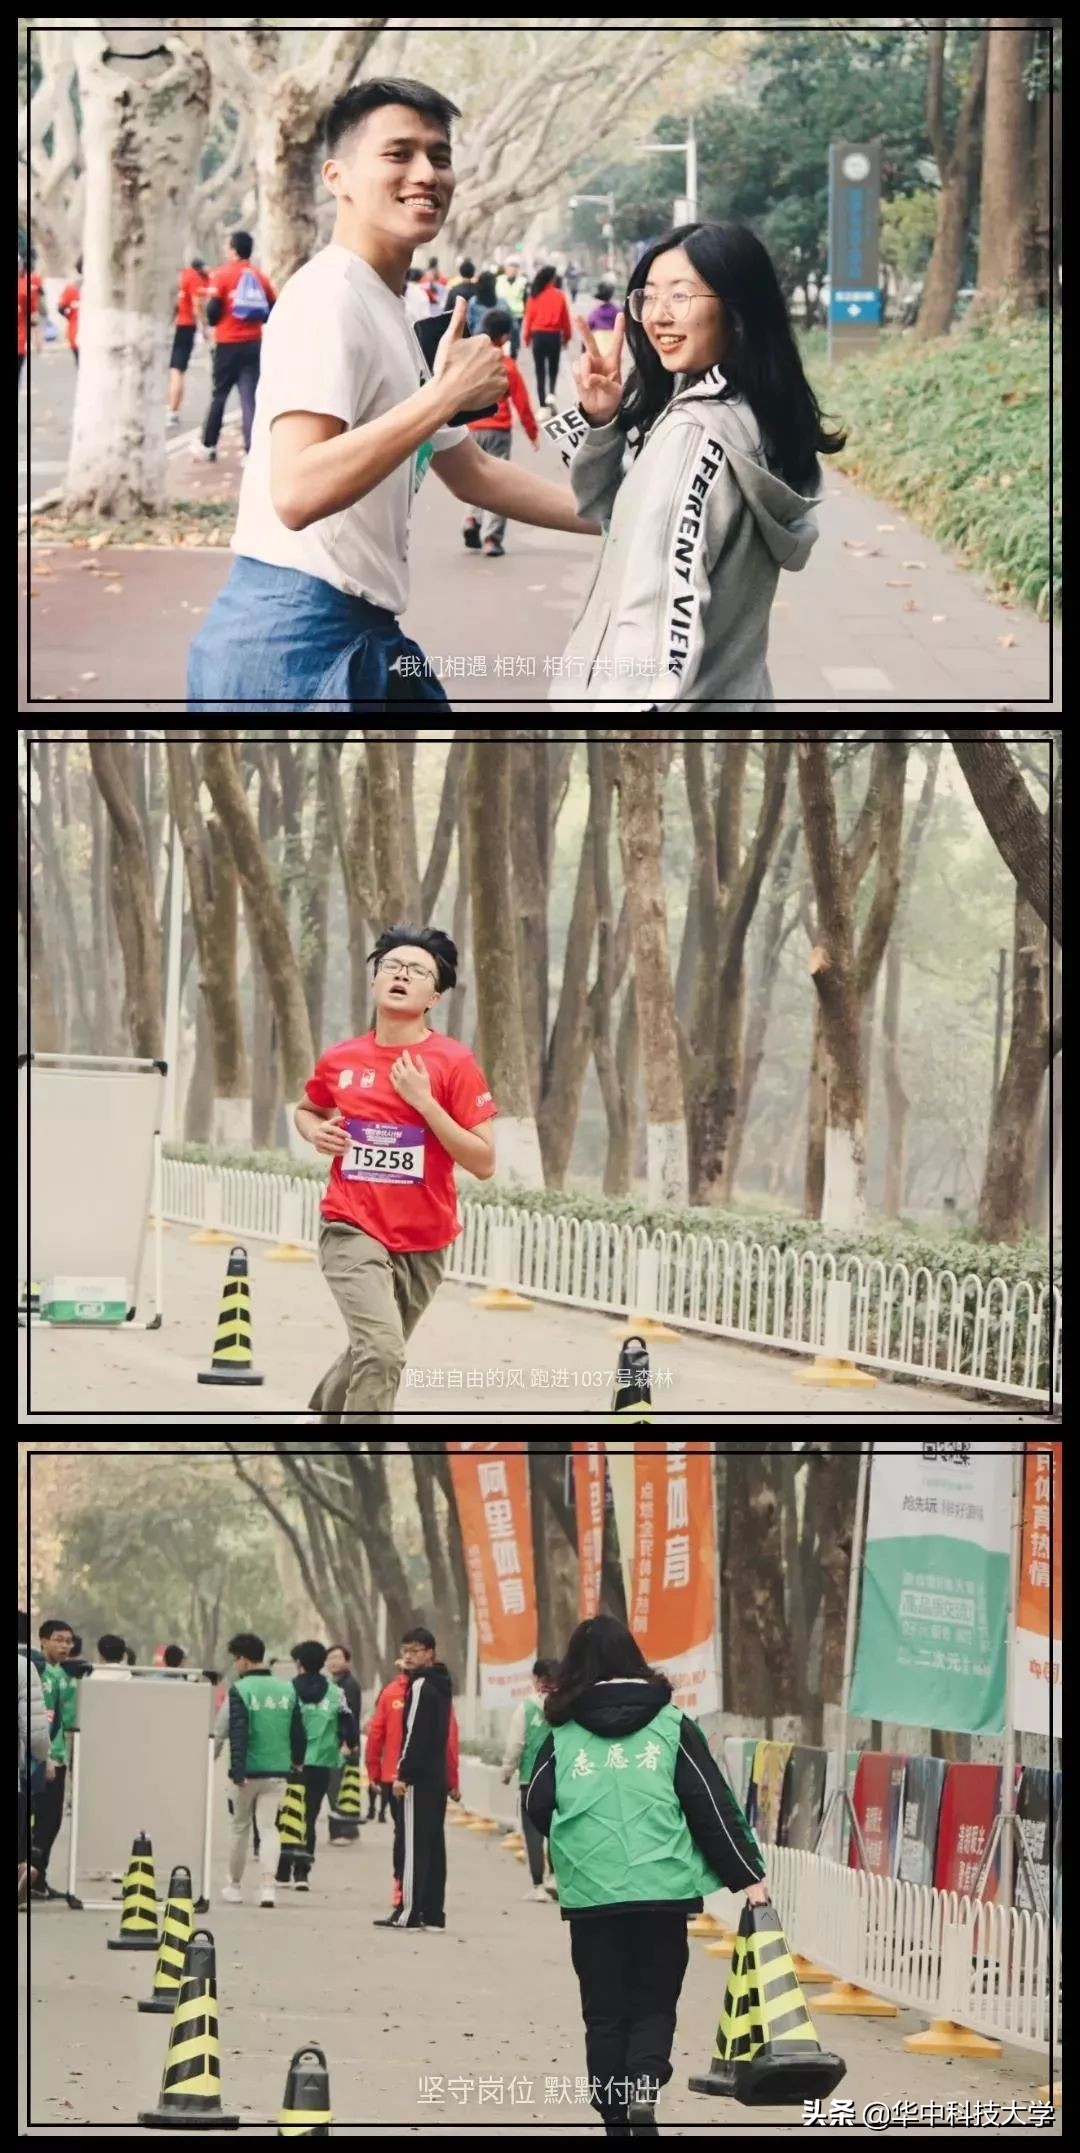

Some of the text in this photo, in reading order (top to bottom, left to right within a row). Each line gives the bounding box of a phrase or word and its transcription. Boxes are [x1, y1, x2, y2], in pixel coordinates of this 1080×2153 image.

[353, 1146, 414, 1170] T5258
[571, 1741, 661, 1780] 志愿者
